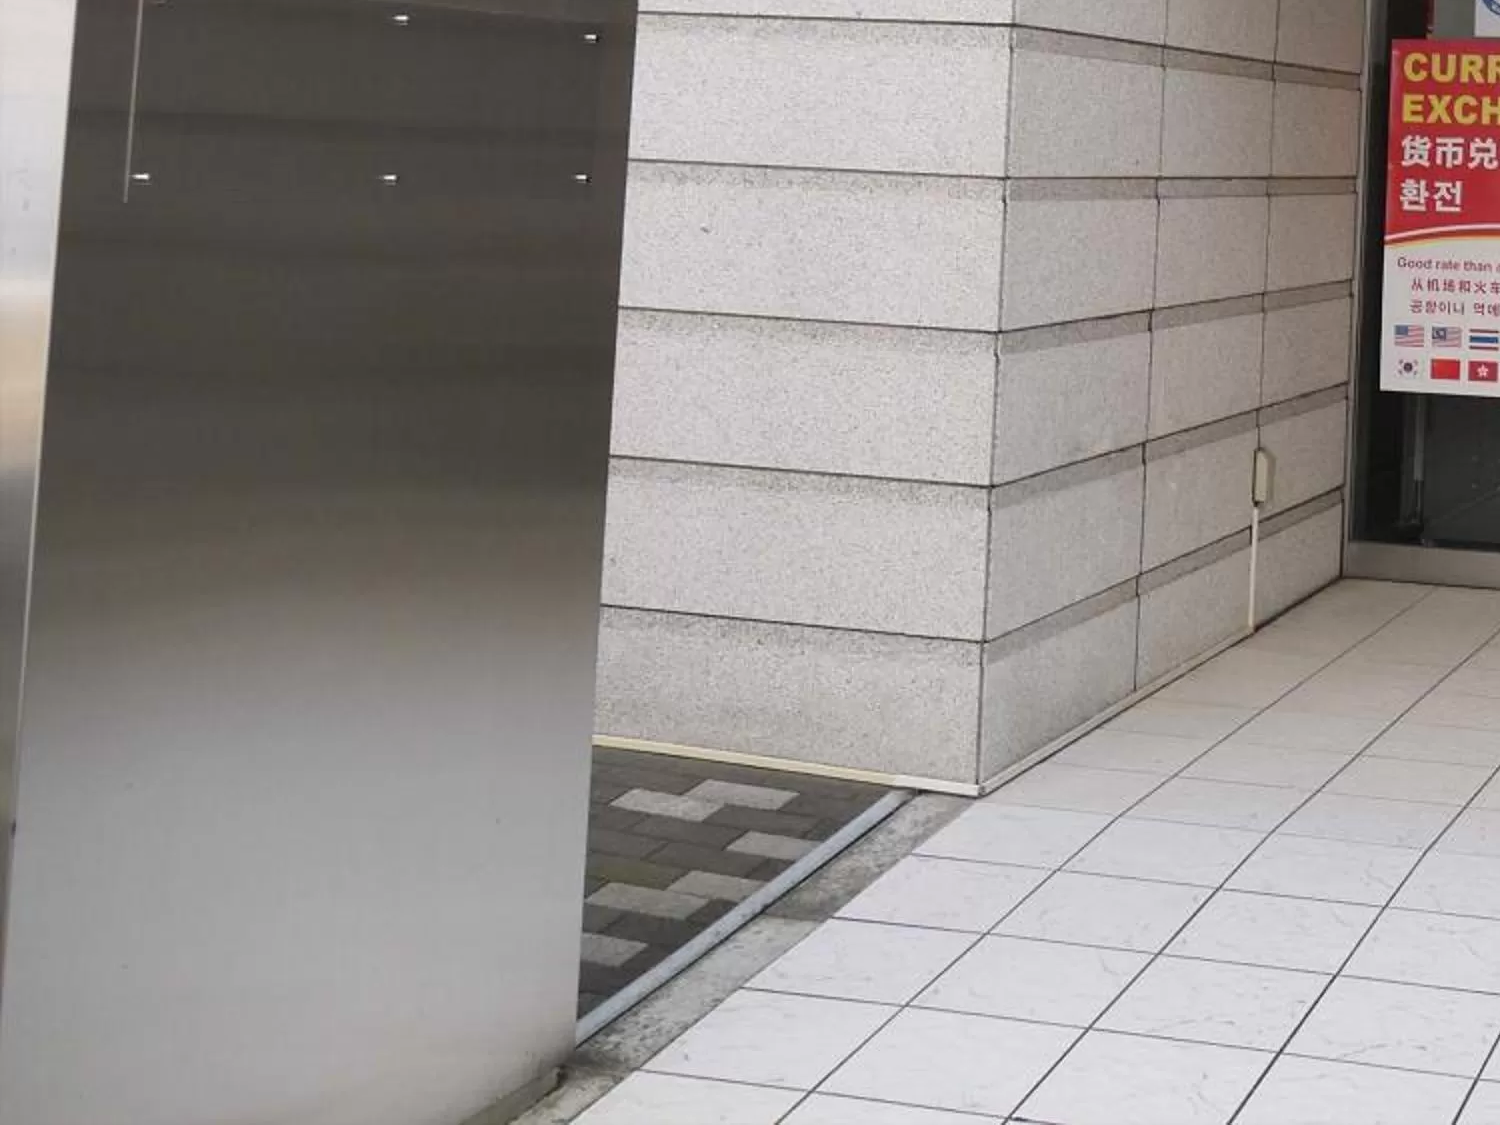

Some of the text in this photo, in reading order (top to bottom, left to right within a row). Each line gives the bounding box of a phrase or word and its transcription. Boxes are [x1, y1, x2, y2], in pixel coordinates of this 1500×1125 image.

[1400, 179, 1462, 212] 환전
[1397, 256, 1432, 270] Good
[1435, 259, 1460, 272] rate
[1463, 260, 1492, 273] than
